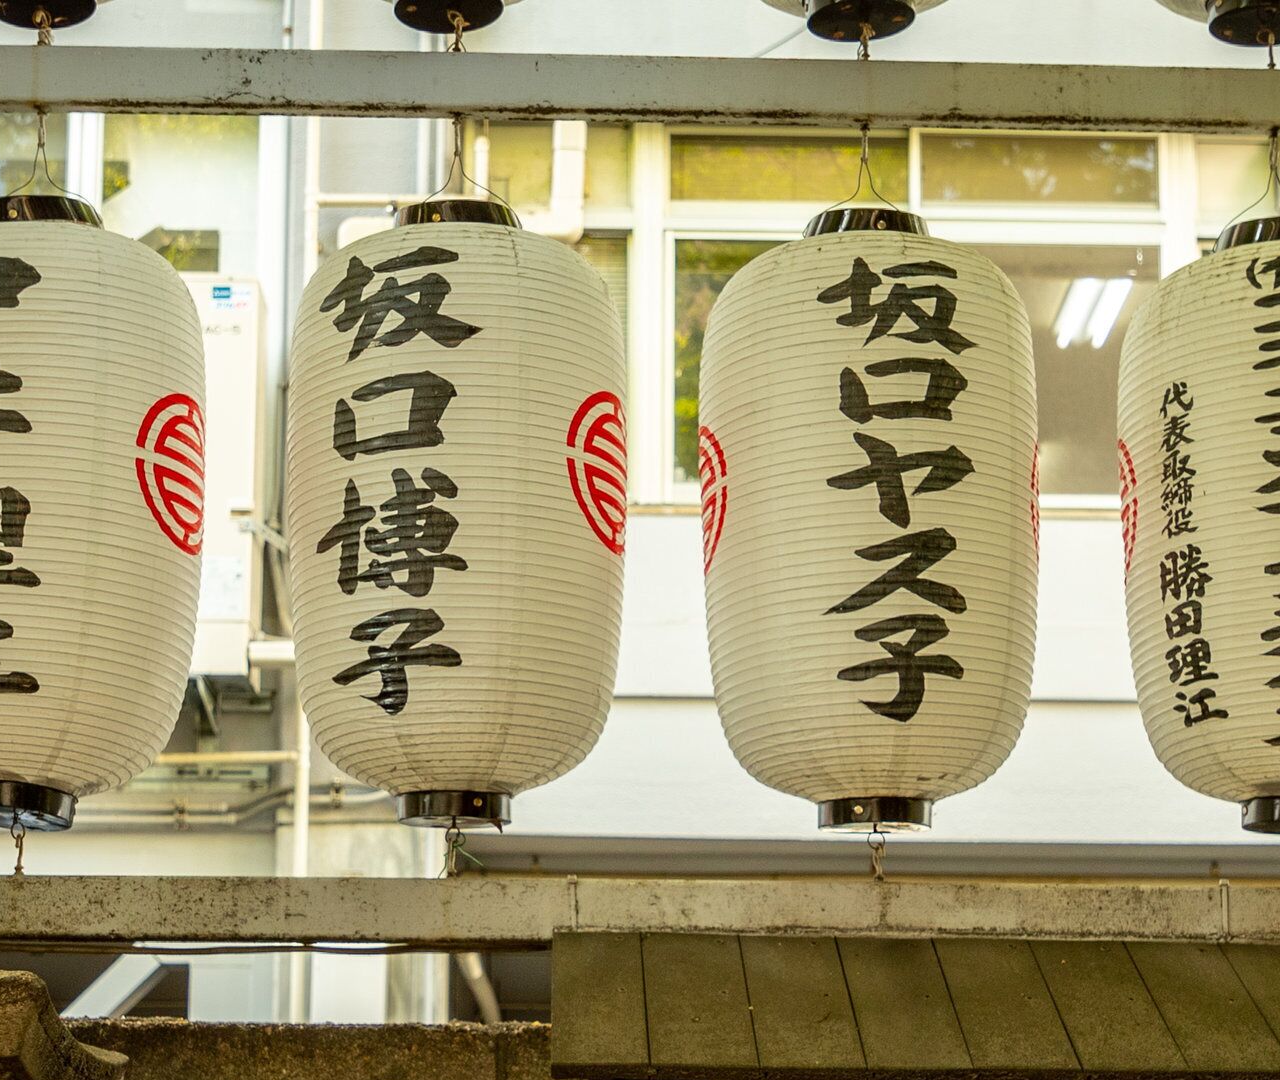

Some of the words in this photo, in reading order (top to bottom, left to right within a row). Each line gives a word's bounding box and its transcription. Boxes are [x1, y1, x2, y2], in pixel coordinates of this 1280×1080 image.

[316, 246, 483, 716] 坂口博子
[816, 255, 978, 723] 坂口ヤス子
[1159, 381, 1199, 538] 代表取締役
[1159, 544, 1229, 727] 勝田理江
